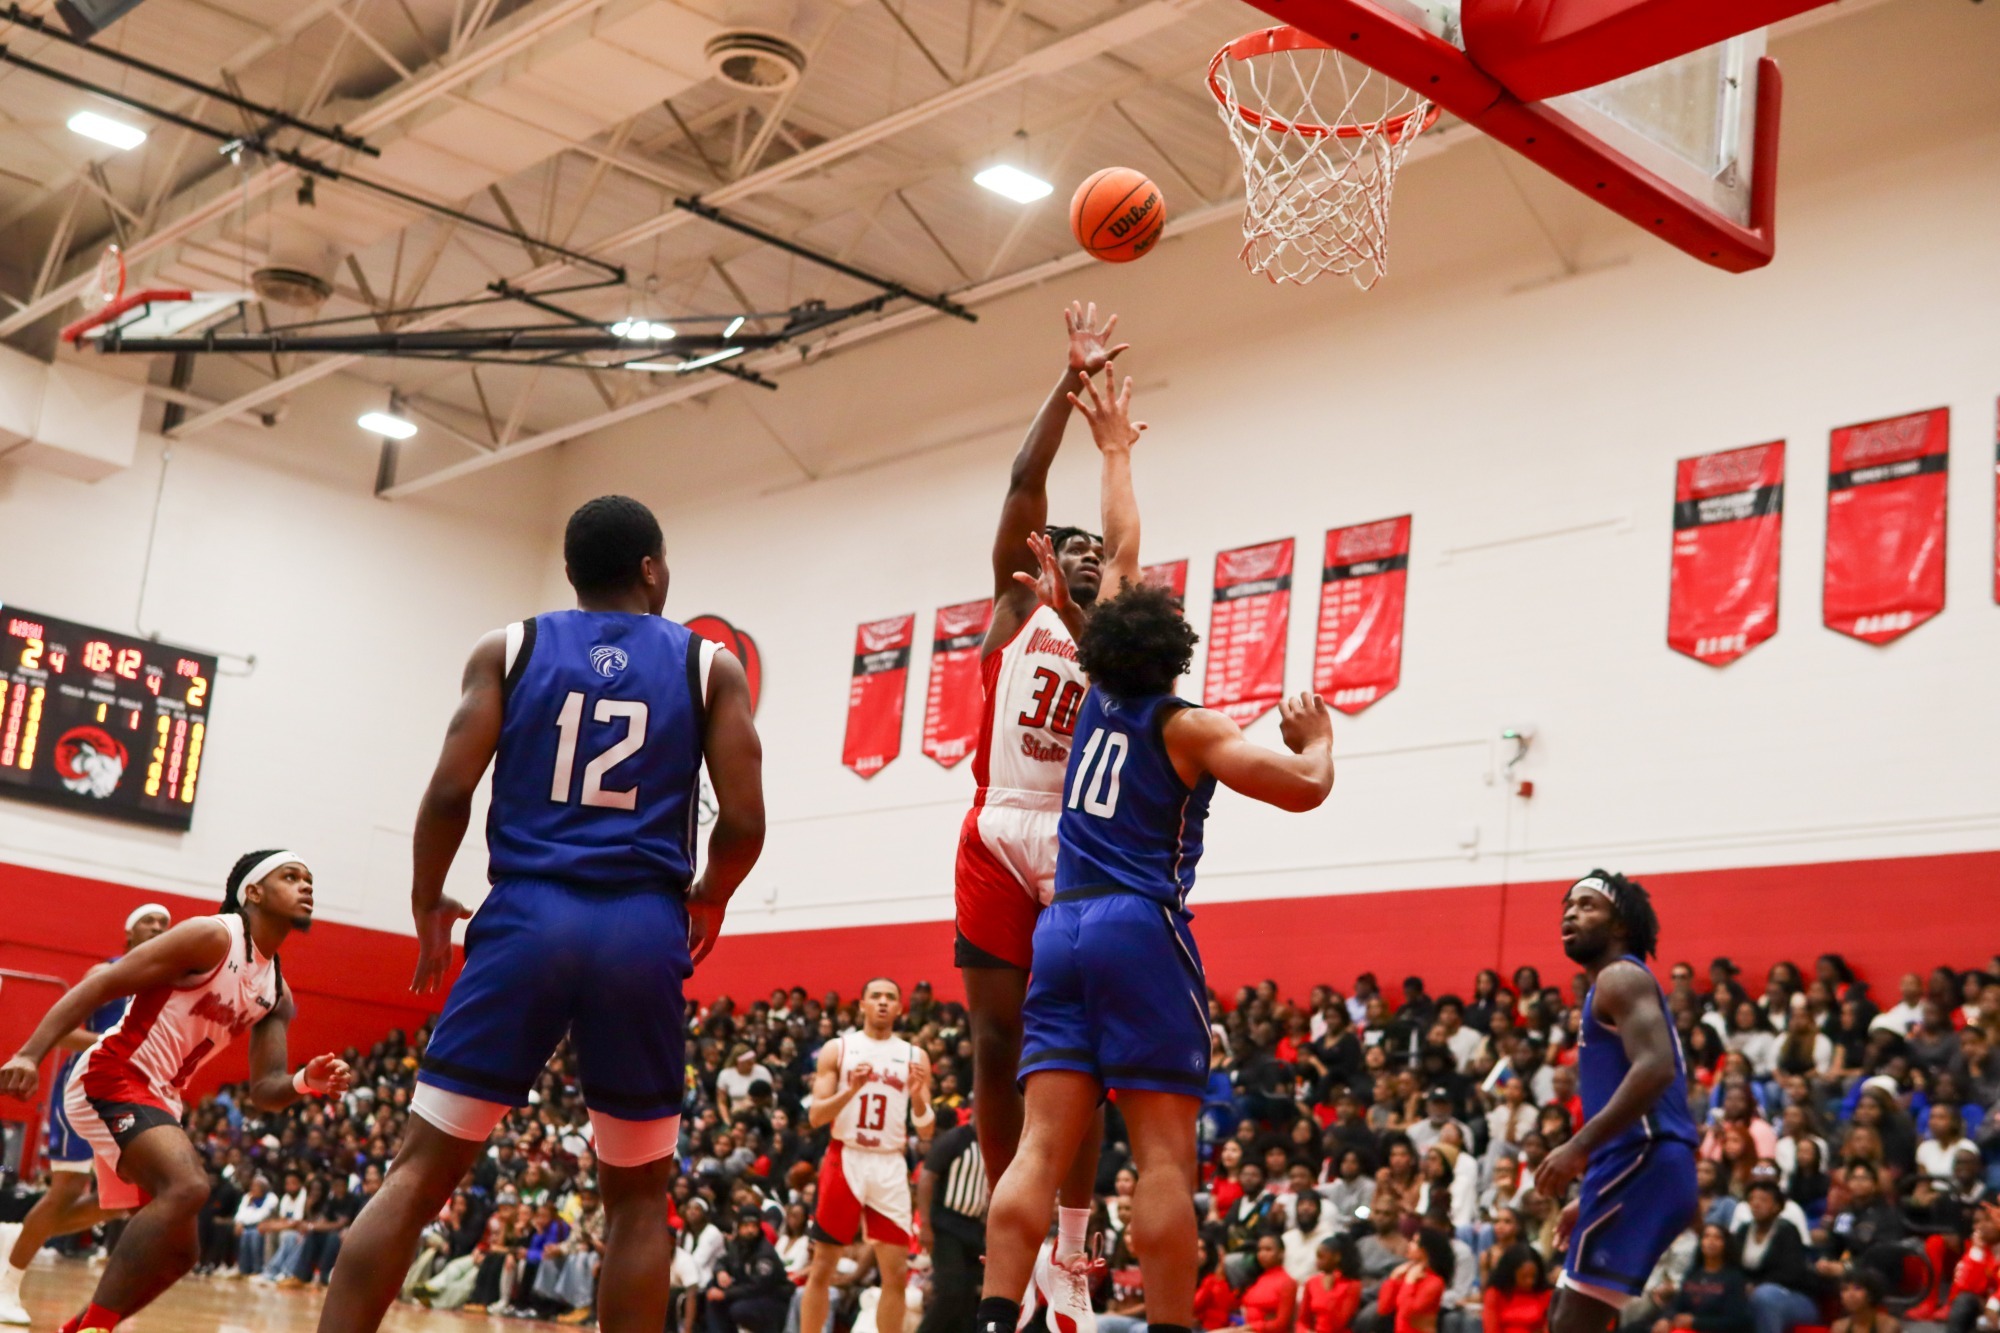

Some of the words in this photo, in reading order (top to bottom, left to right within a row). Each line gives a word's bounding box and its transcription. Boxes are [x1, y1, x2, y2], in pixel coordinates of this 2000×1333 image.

[1108, 193, 1157, 238] Wilson
[21, 638, 44, 669] 2
[49, 652, 65, 674] 4
[83, 641, 142, 680] 18:12
[146, 674, 161, 696] 4
[187, 676, 207, 707] 2
[1018, 666, 1084, 736] 30
[550, 691, 648, 811] 12
[1020, 732, 1068, 762] State
[1067, 728, 1129, 819] 10
[857, 1093, 887, 1131] 13
